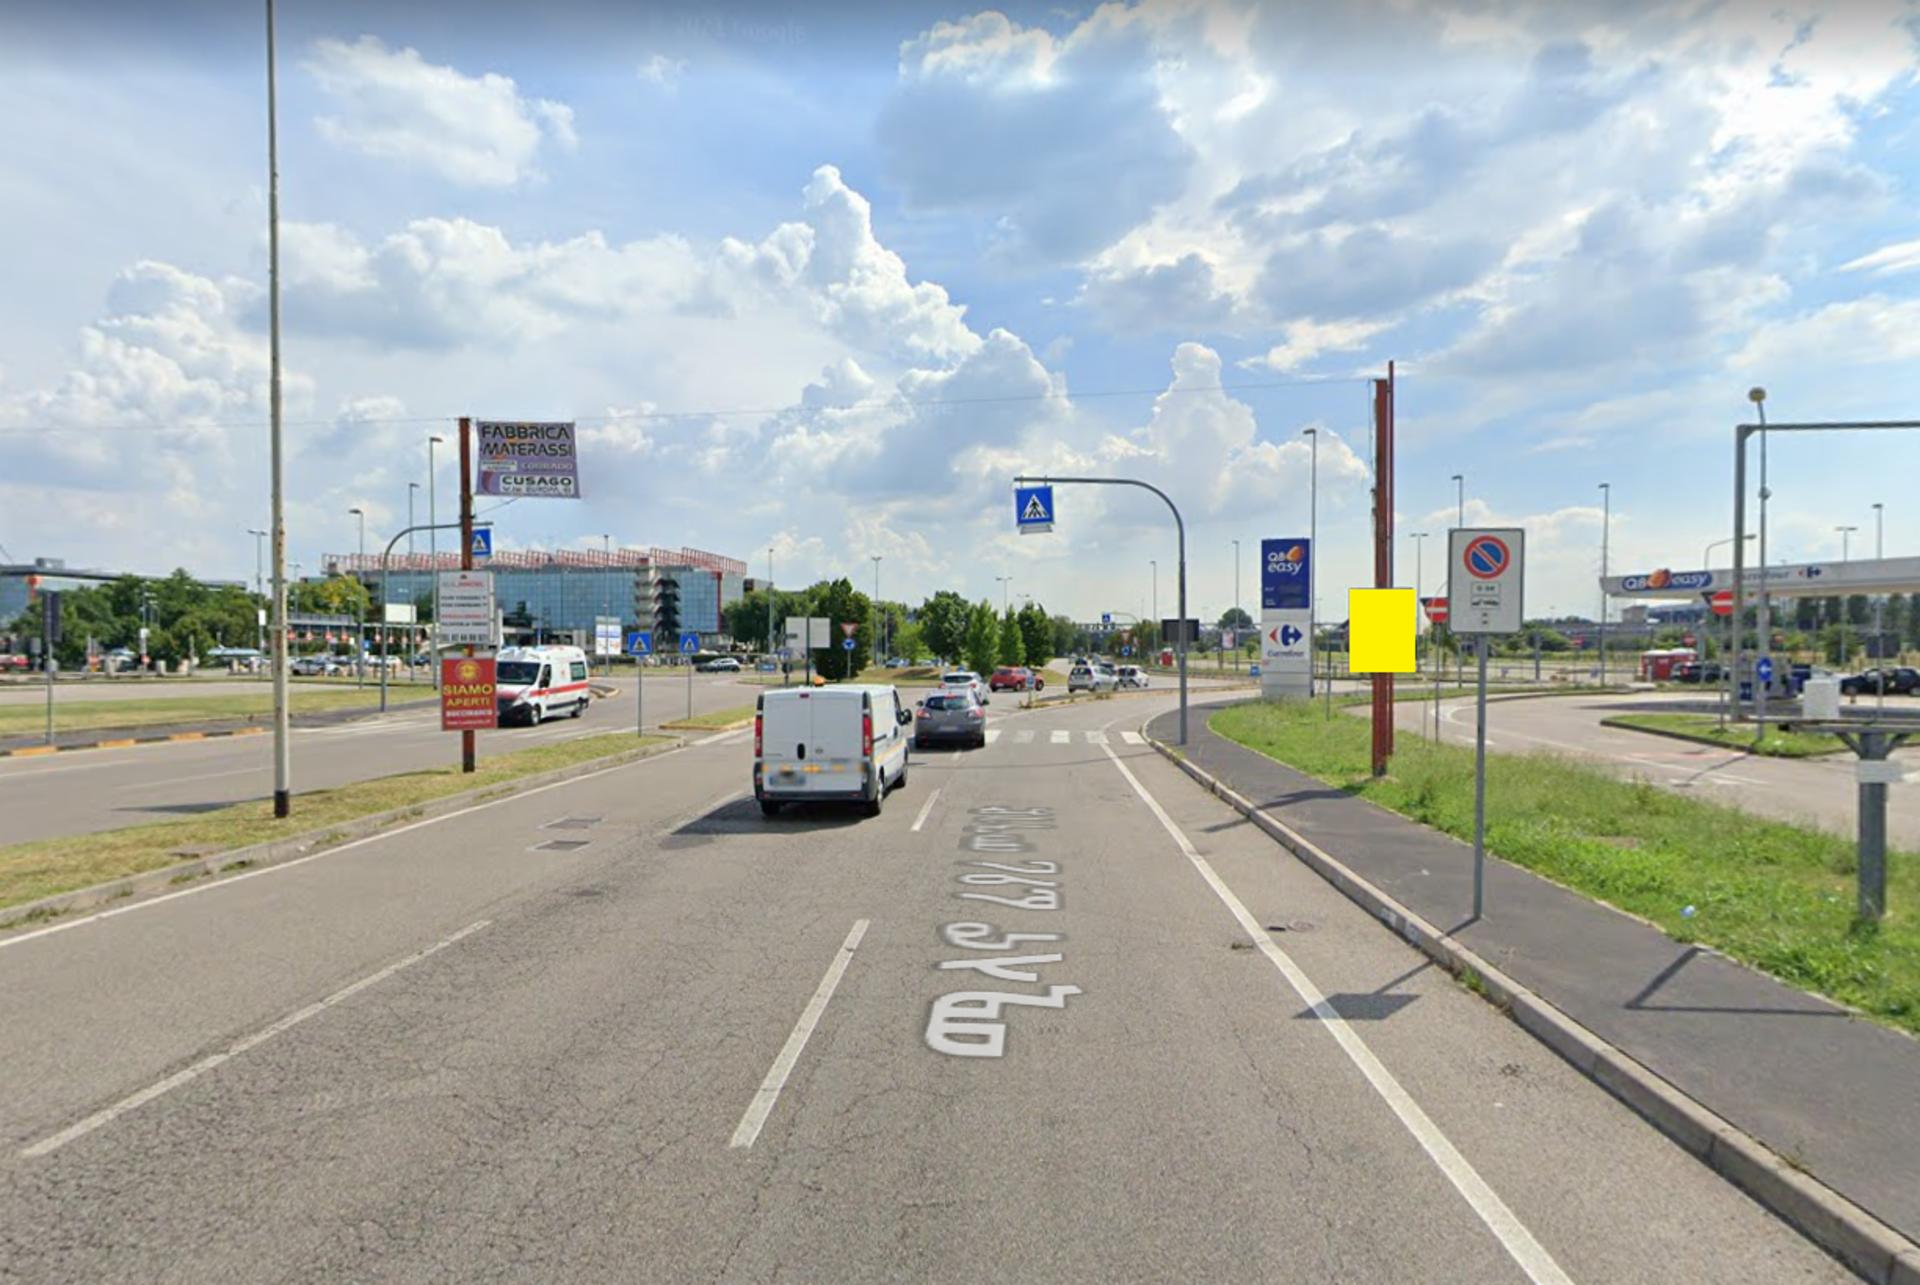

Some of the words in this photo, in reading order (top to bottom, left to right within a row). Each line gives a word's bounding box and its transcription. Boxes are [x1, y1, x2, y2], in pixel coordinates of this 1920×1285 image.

[482, 425, 570, 440] FABBRICA
[482, 442, 573, 457] MATERASSI
[502, 475, 572, 486] CUSAGO
[1267, 552, 1286, 562] Q8
[1267, 562, 1303, 576] easy
[1624, 577, 1648, 590] Q8
[1671, 574, 1709, 588] easy
[443, 684, 493, 696] SIAMO
[446, 697, 491, 707] APERTI
